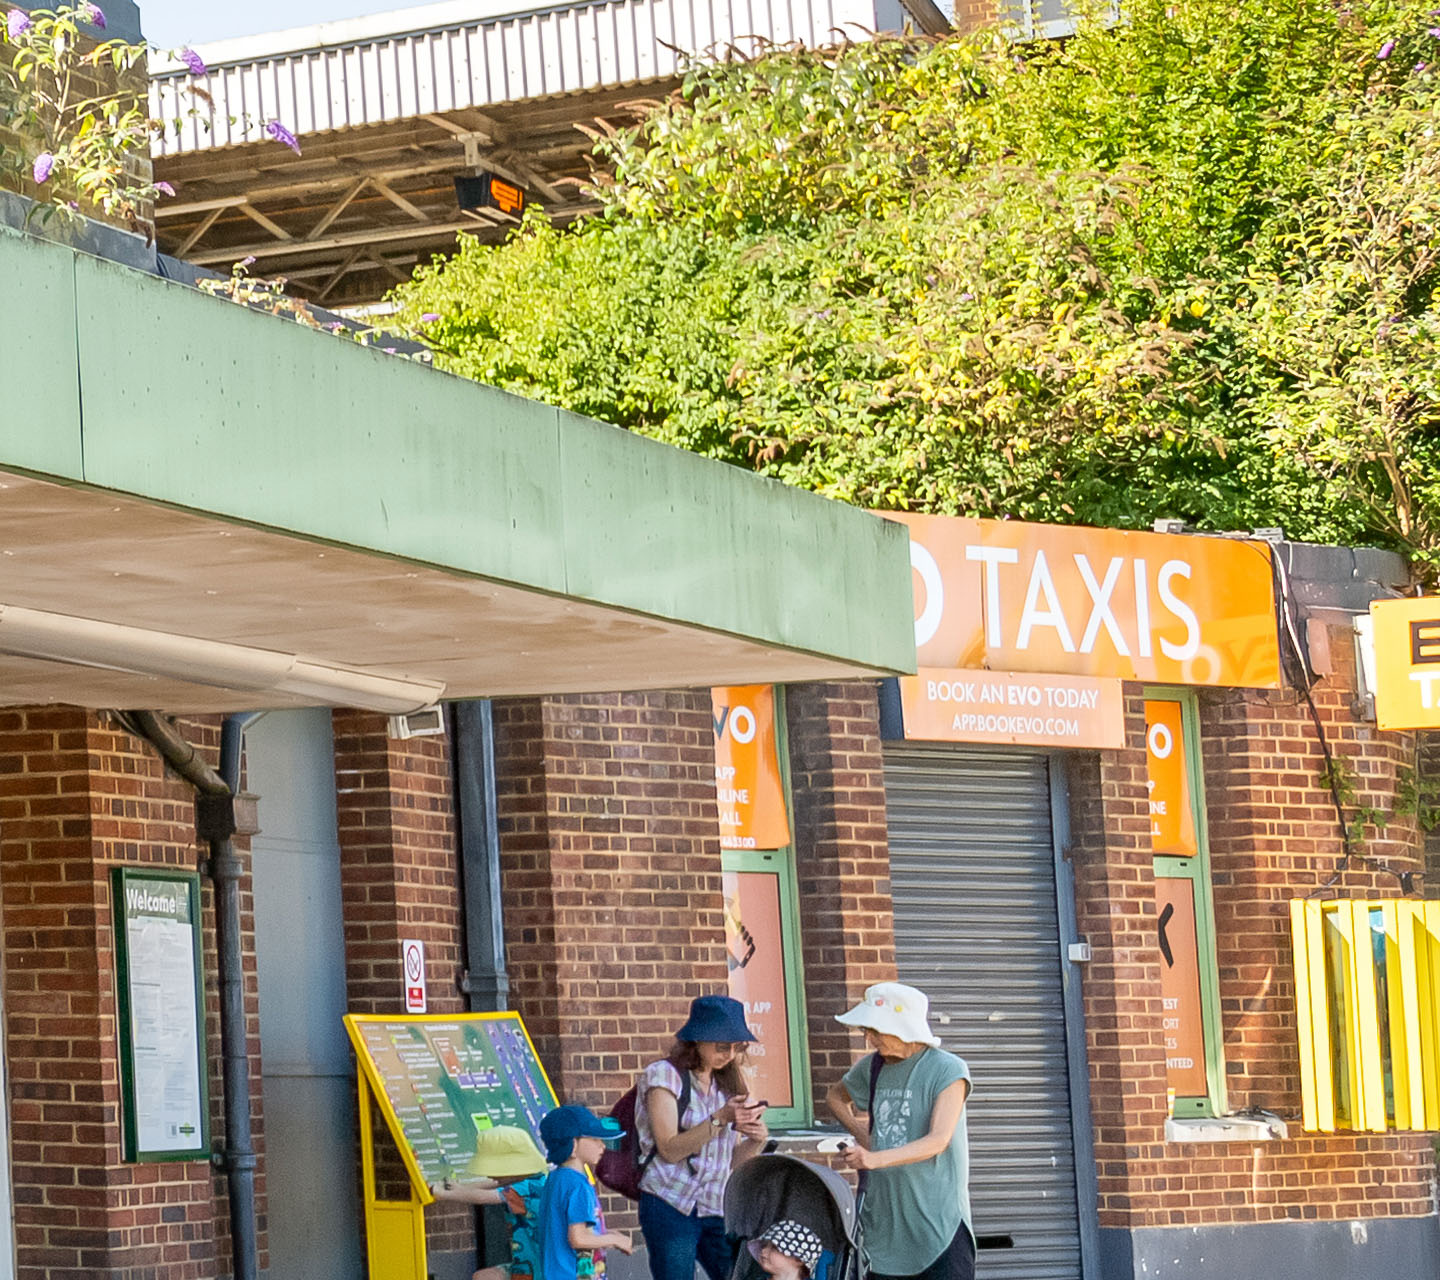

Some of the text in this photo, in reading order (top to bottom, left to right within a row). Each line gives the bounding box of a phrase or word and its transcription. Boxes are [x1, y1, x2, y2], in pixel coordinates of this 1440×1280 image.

[965, 545, 1200, 661] TAXIS
[927, 681, 1099, 710] BOOK AN EVO TODAY
[952, 714, 1079, 737] APP.BOOKEVO.COM
[126, 887, 176, 914] Welcome
